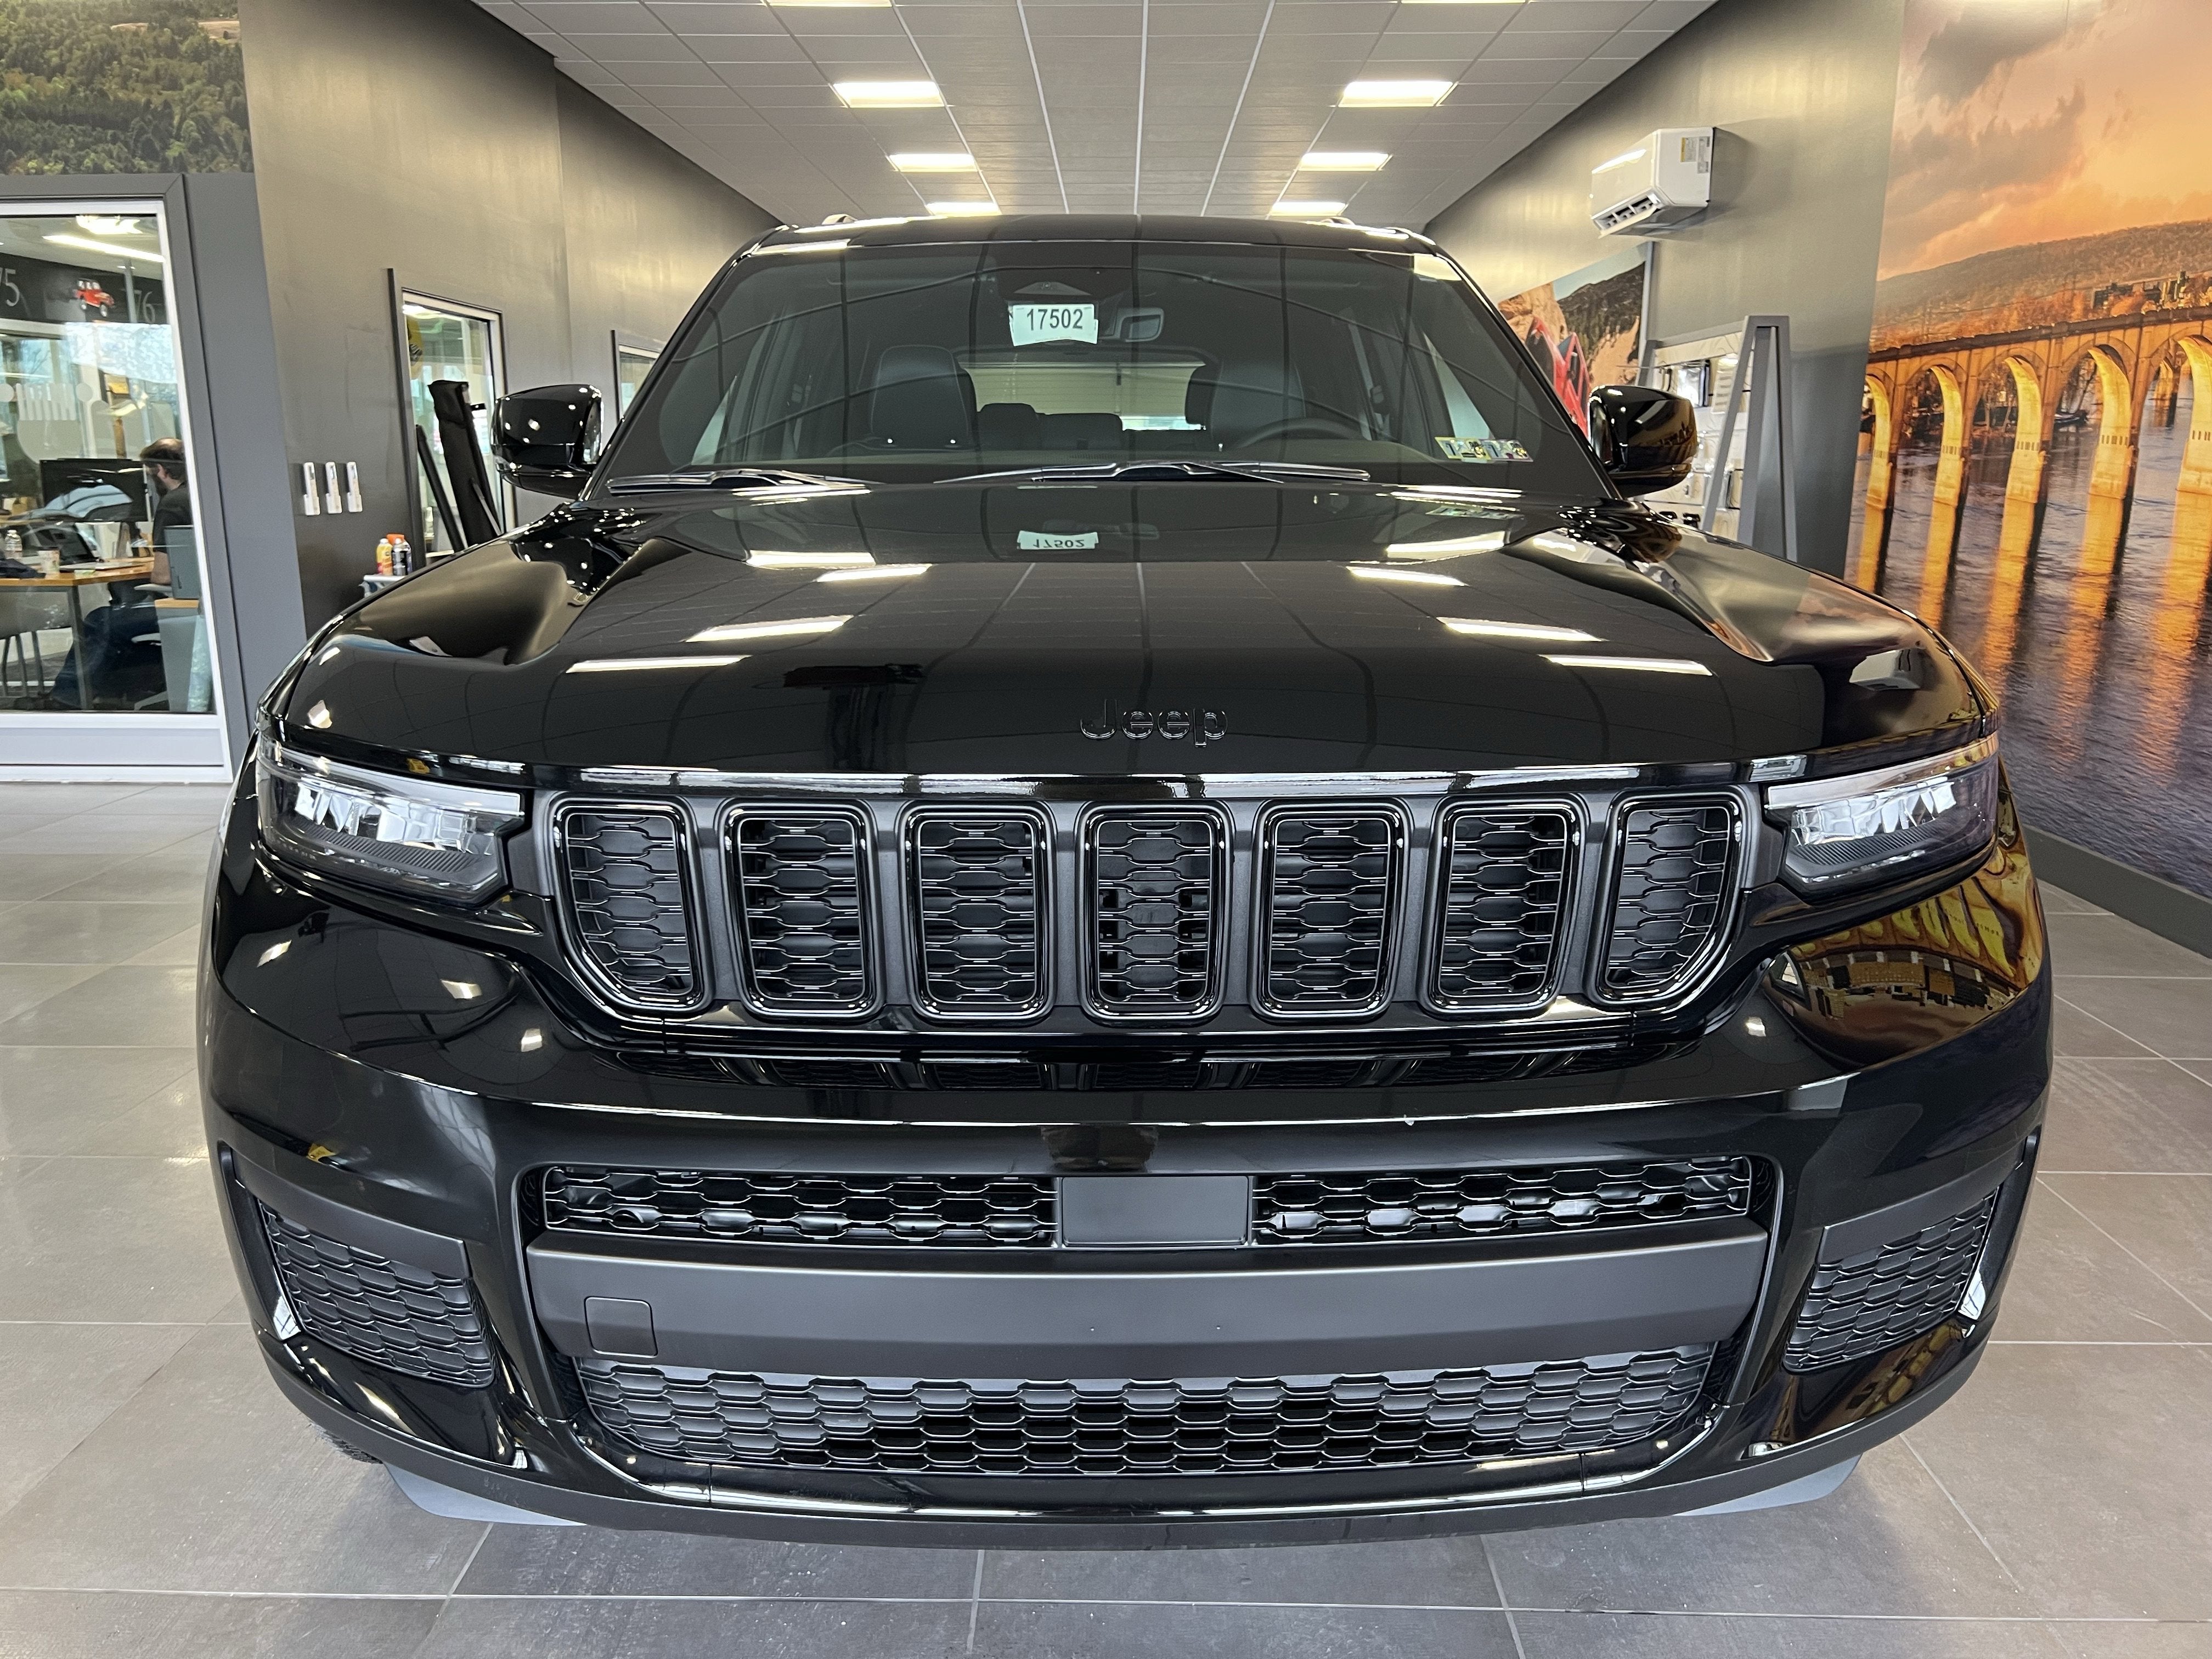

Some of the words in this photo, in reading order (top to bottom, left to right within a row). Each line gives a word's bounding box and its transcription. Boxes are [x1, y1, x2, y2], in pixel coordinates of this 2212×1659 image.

[0, 267, 20, 307] 5
[1027, 308, 1083, 331] 17502
[1080, 699, 1228, 747] Jeep
